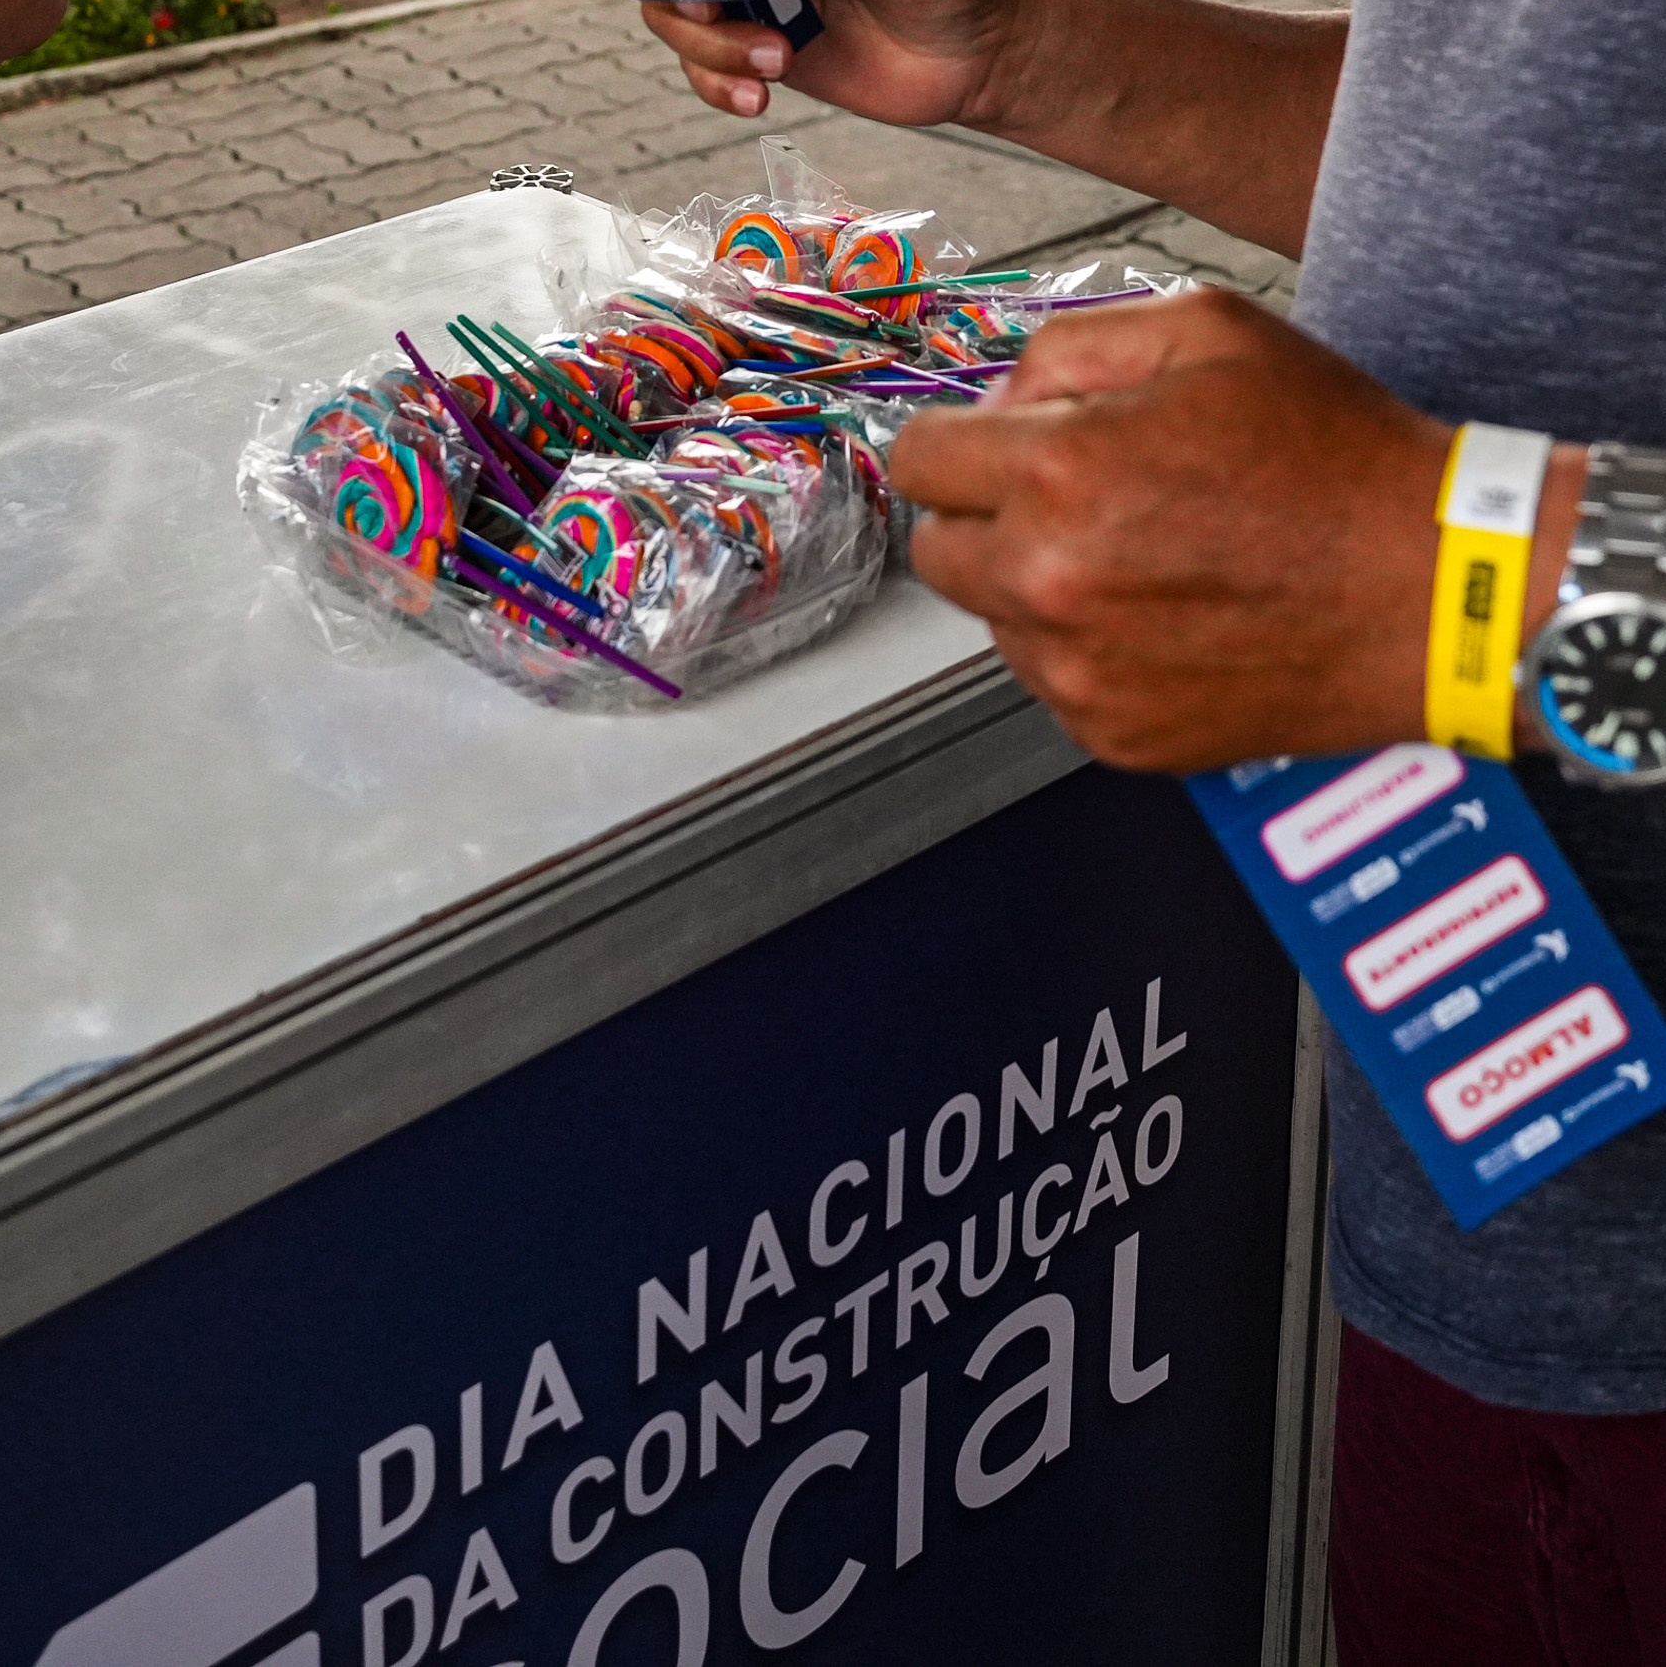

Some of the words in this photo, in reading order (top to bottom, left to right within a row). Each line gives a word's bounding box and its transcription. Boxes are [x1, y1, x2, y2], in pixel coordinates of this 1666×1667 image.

[358, 1339, 584, 1559] DIA
[637, 975, 1188, 1386] NACIONAL
[1456, 1013, 1594, 1110] ALMOÇO
[362, 1526, 520, 1667] DA
[550, 1094, 1183, 1565] CONSTRUÇÃO
[485, 1231, 1171, 1667] ocial
